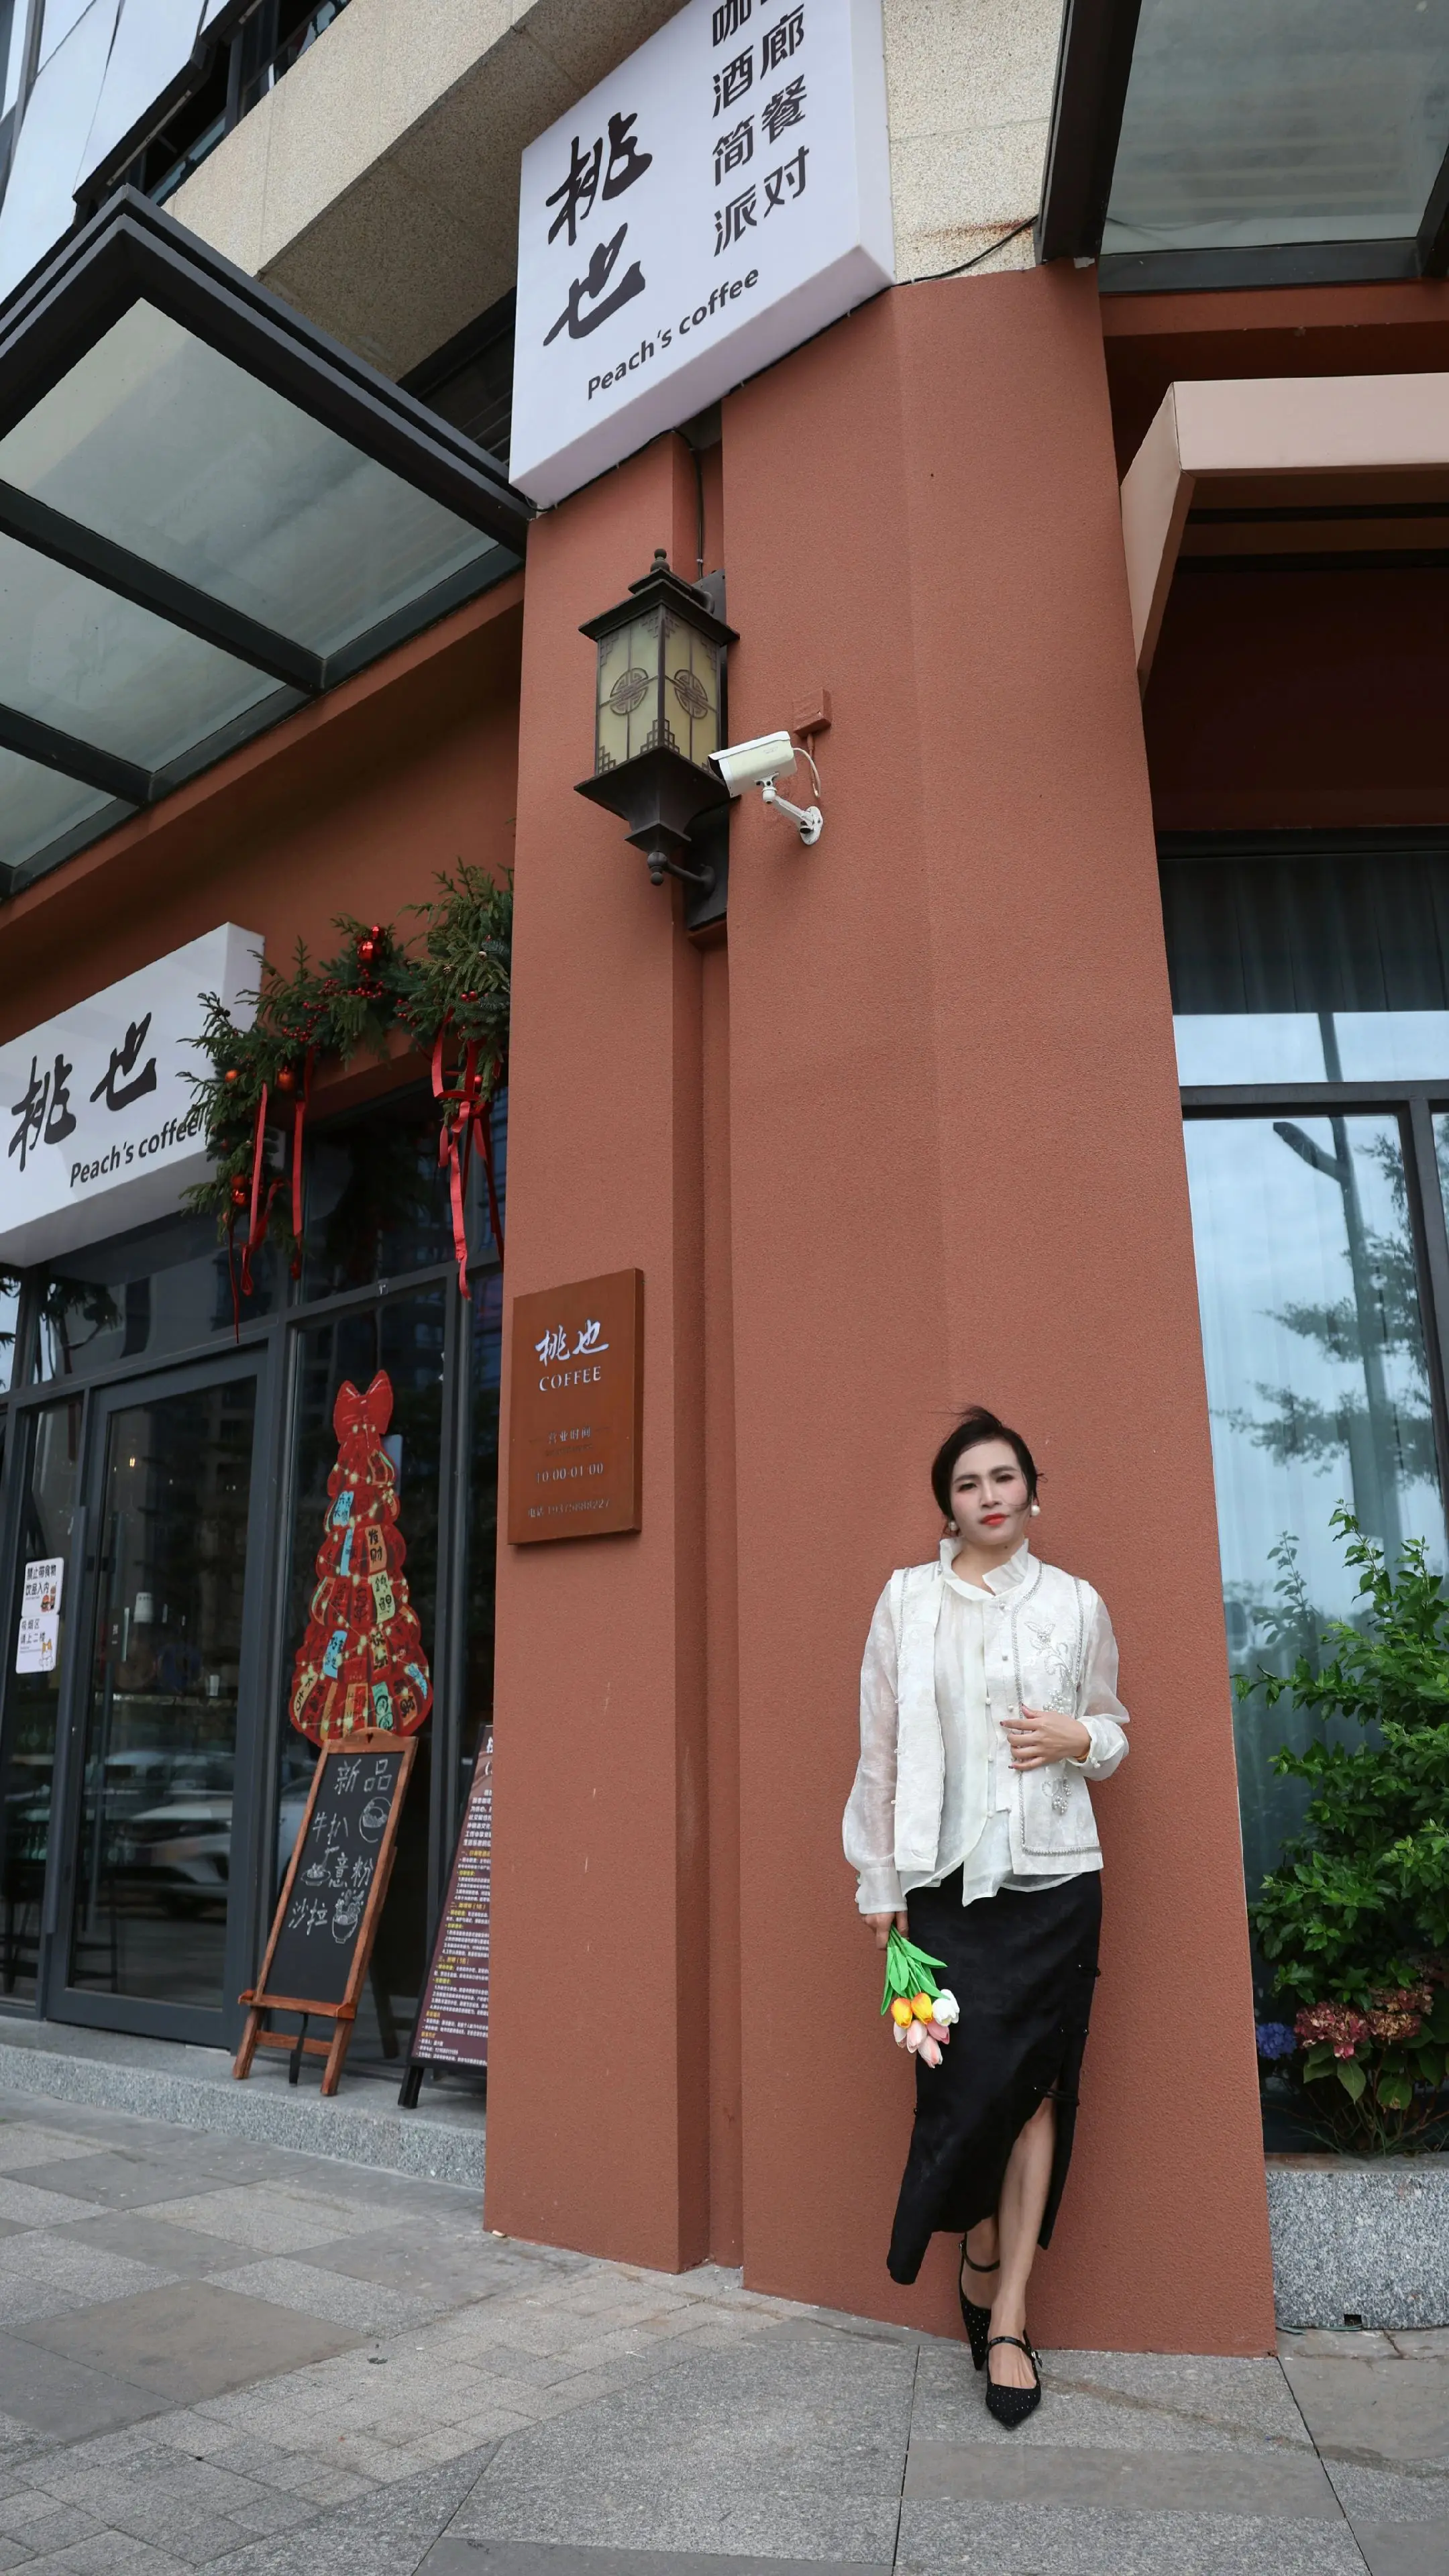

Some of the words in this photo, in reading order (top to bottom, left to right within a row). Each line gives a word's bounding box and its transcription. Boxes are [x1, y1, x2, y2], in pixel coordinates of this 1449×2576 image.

[712, 0, 769, 47] 咖
[712, 3, 804, 118] 酒廊
[712, 74, 807, 186] 简餐
[714, 146, 810, 257] 派对
[588, 331, 672, 400] Peach's
[679, 268, 759, 335] coffee
[70, 1140, 134, 1187] Peach's
[138, 1113, 198, 1159] coffee
[539, 1366, 602, 1391] COFFEE
[335, 1758, 392, 1794] 新品
[313, 1811, 349, 1844] 牛扒
[329, 1852, 373, 1888] 意粉
[288, 1898, 327, 1935] 沙拉
